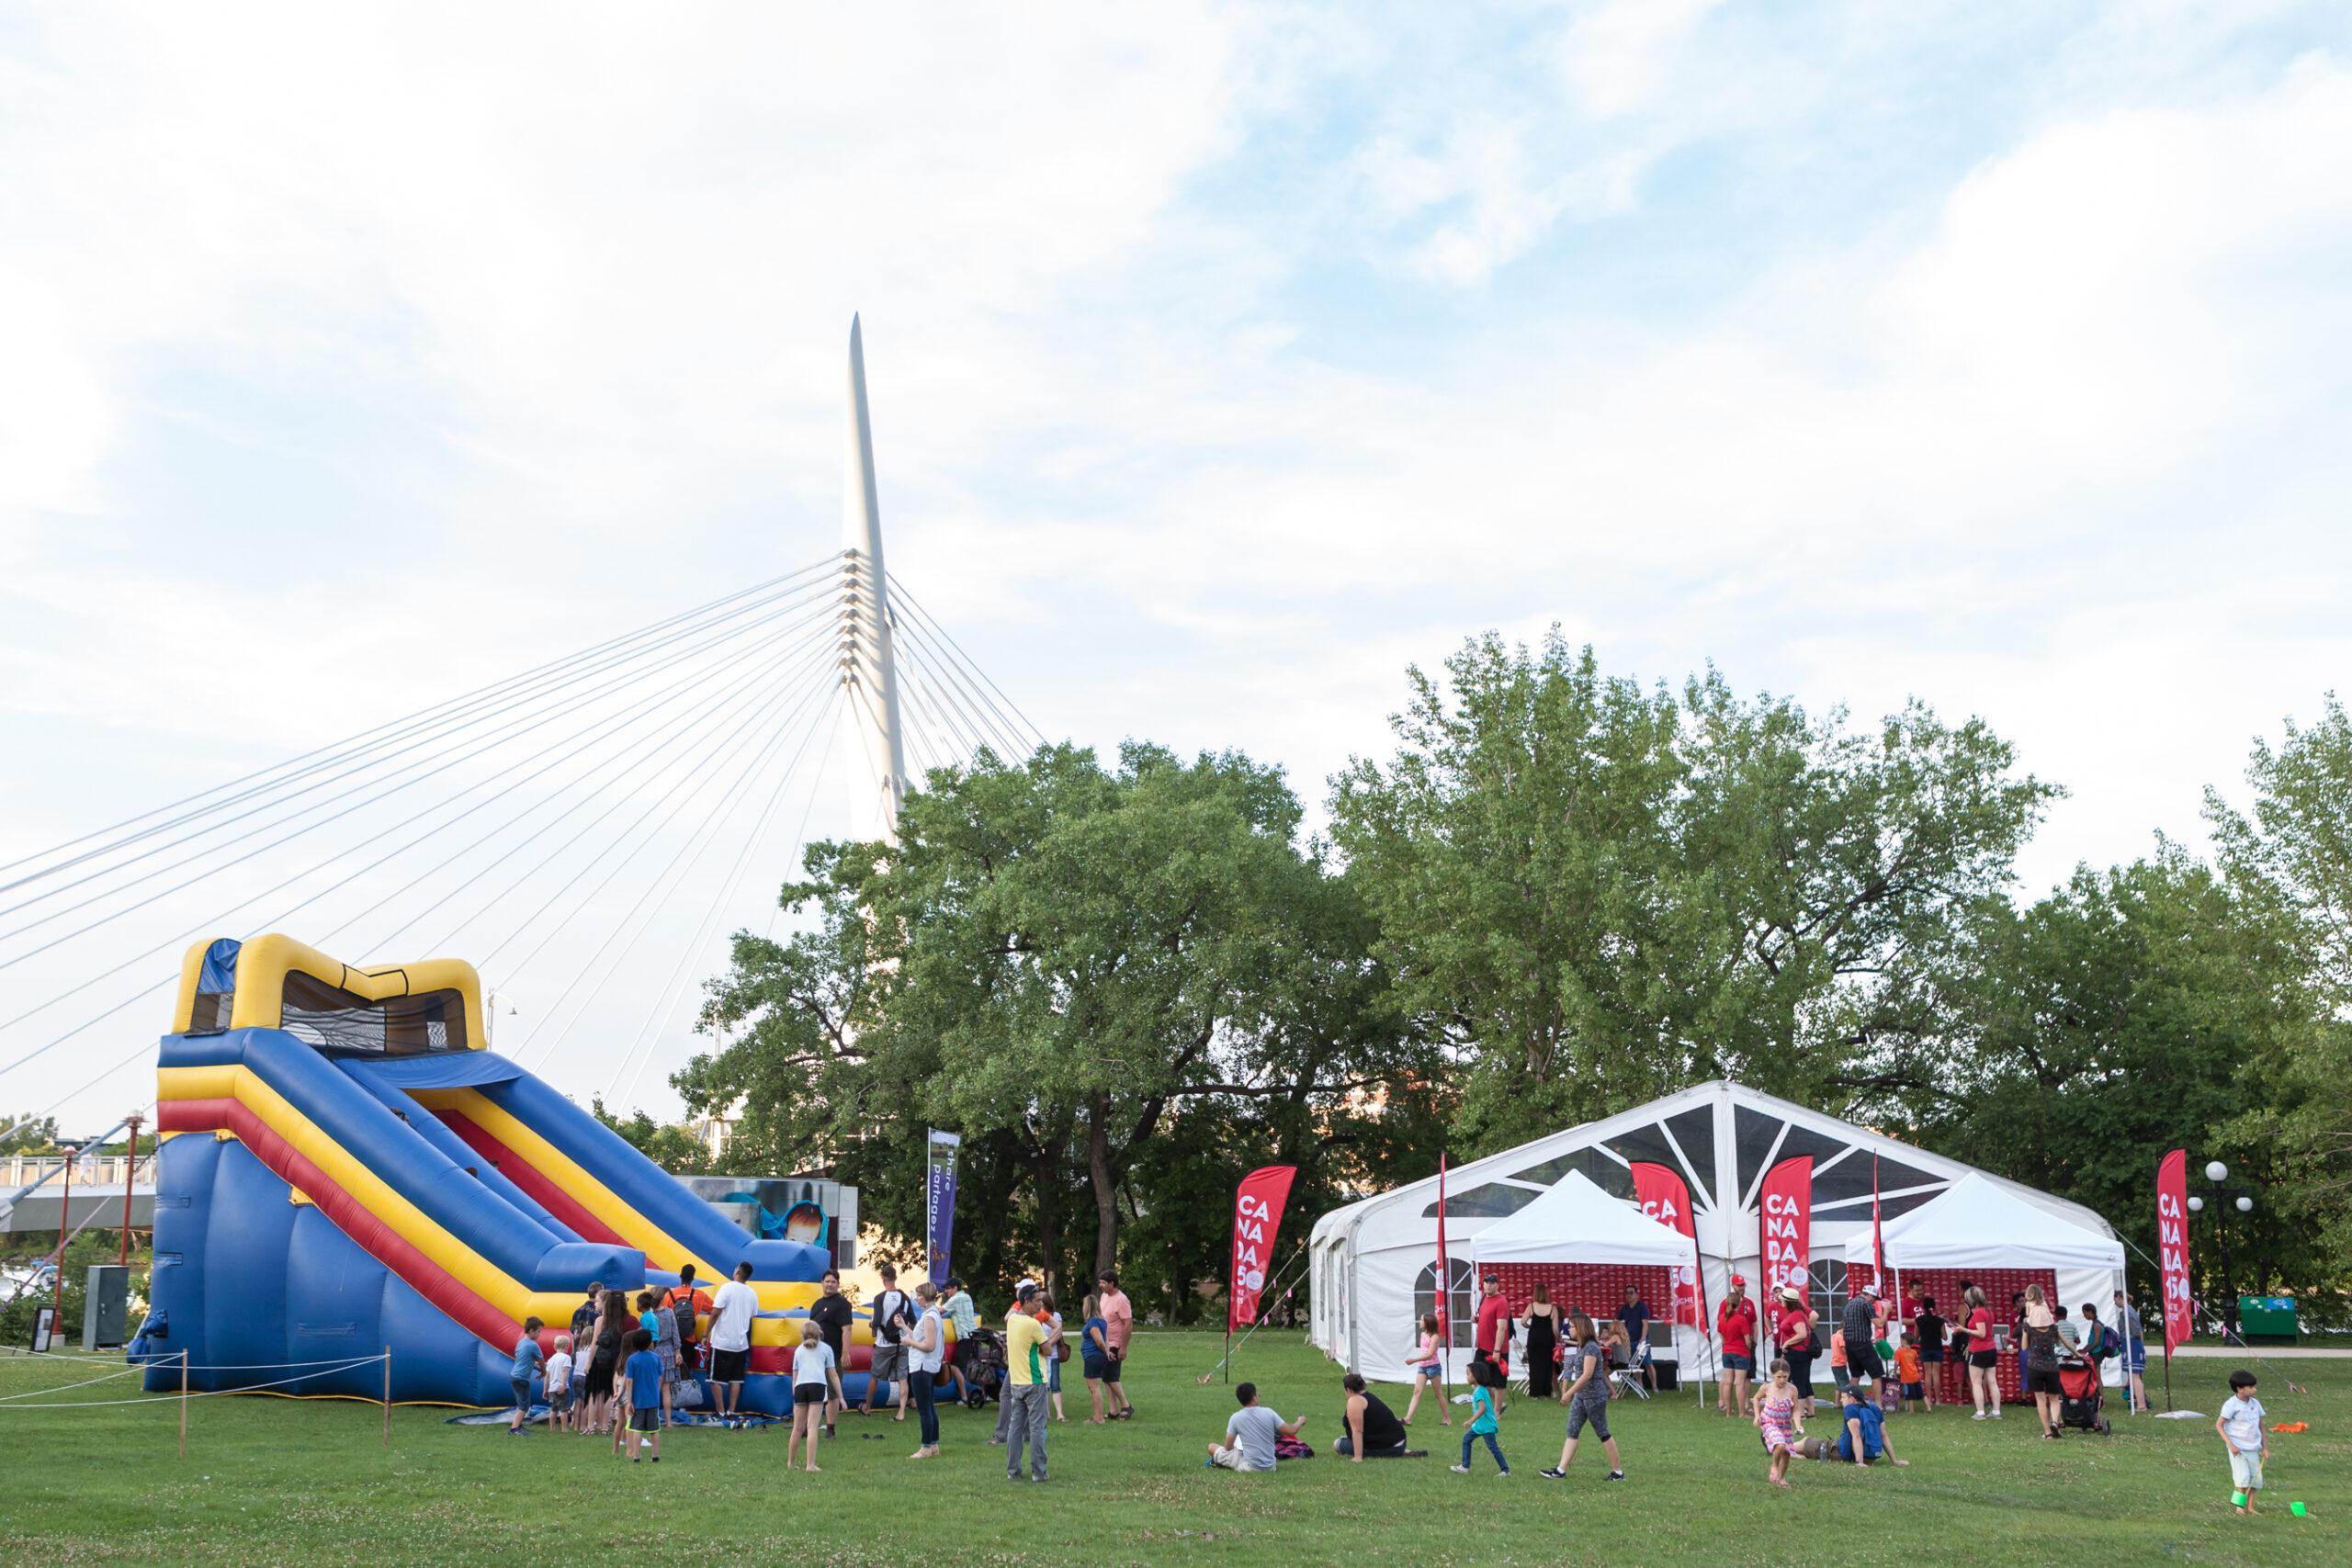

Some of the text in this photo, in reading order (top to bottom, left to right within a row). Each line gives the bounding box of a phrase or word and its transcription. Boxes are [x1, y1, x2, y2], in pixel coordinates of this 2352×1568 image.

[945, 1151, 956, 1191] share
[931, 1164, 942, 1232] partagez
[1238, 1195, 1269, 1222] CA
[1642, 1198, 1678, 1221] CA
[1766, 1194, 1800, 1216] CA
[2160, 1193, 2181, 1219] CA
[1238, 1217, 1263, 1244] NA
[1767, 1217, 1799, 1239] NA
[2161, 1220, 2182, 1246] NA
[1768, 1240, 1798, 1262] DA
[2163, 1247, 2183, 1272] DA
